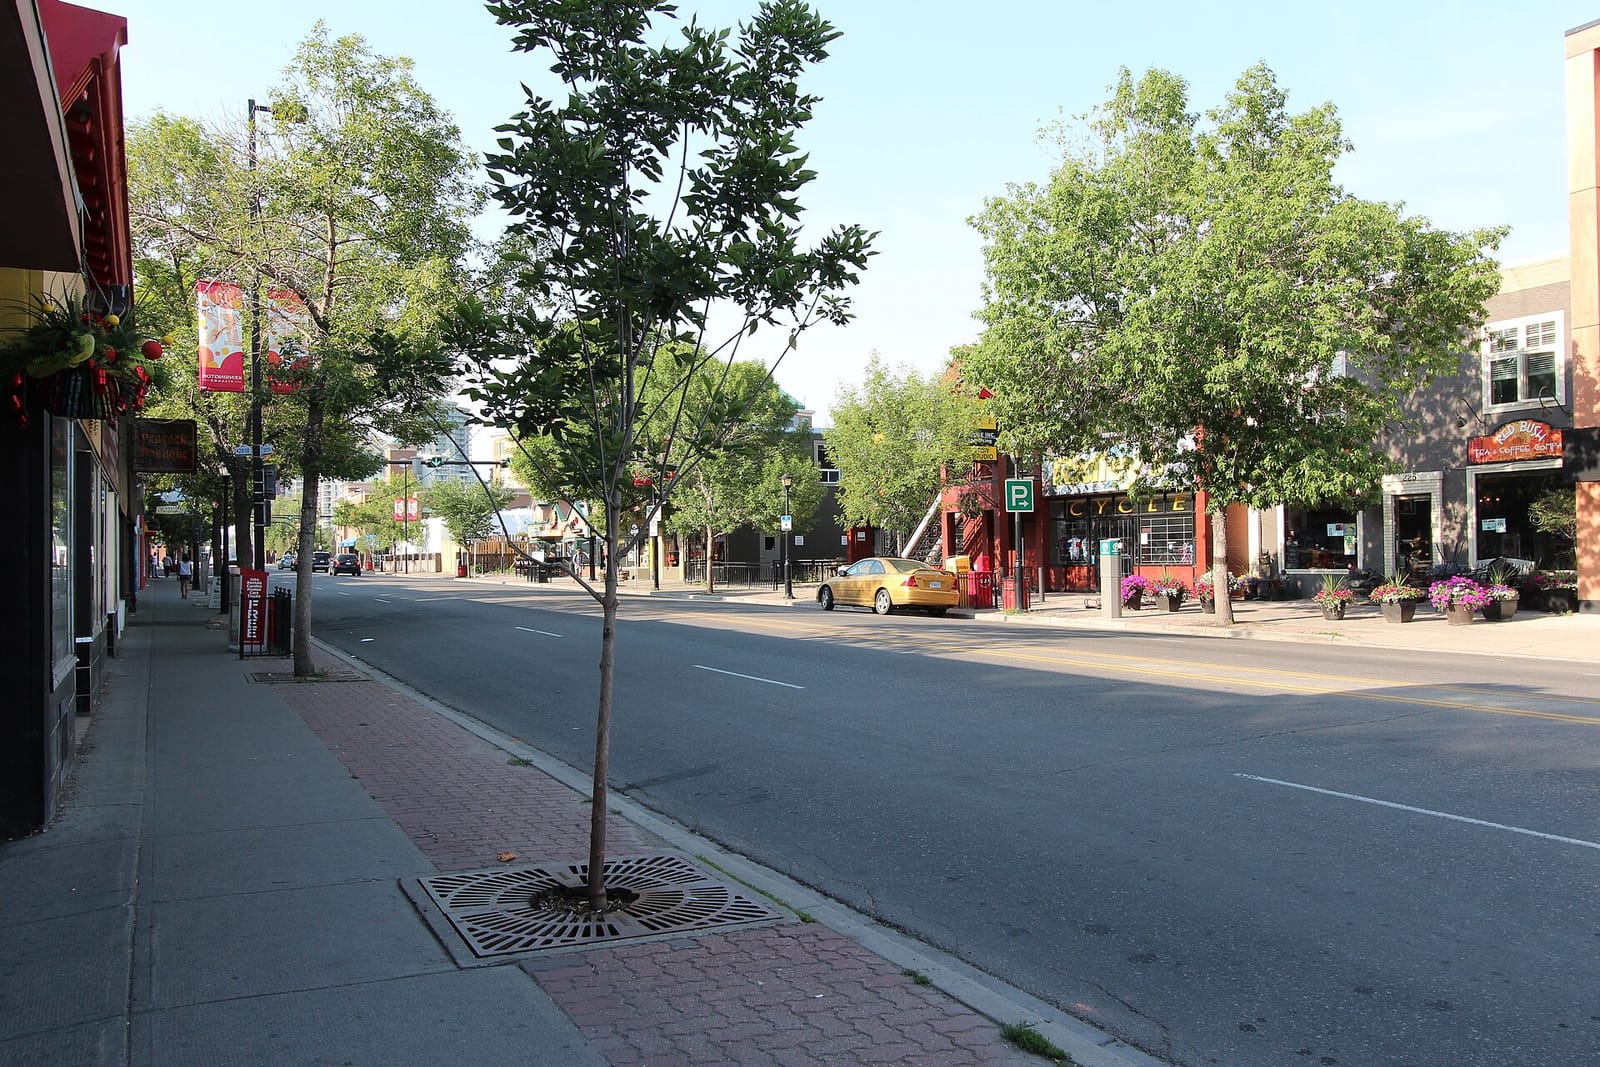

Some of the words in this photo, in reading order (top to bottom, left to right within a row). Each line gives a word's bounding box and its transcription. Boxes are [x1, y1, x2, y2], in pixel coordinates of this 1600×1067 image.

[1496, 424, 1515, 445] RED
[1520, 421, 1547, 442] BUSH
[1473, 448, 1491, 458] TEA
[1011, 485, 1029, 507] P
[1069, 494, 1187, 517] CYCLE
[247, 600, 259, 638] FREE
